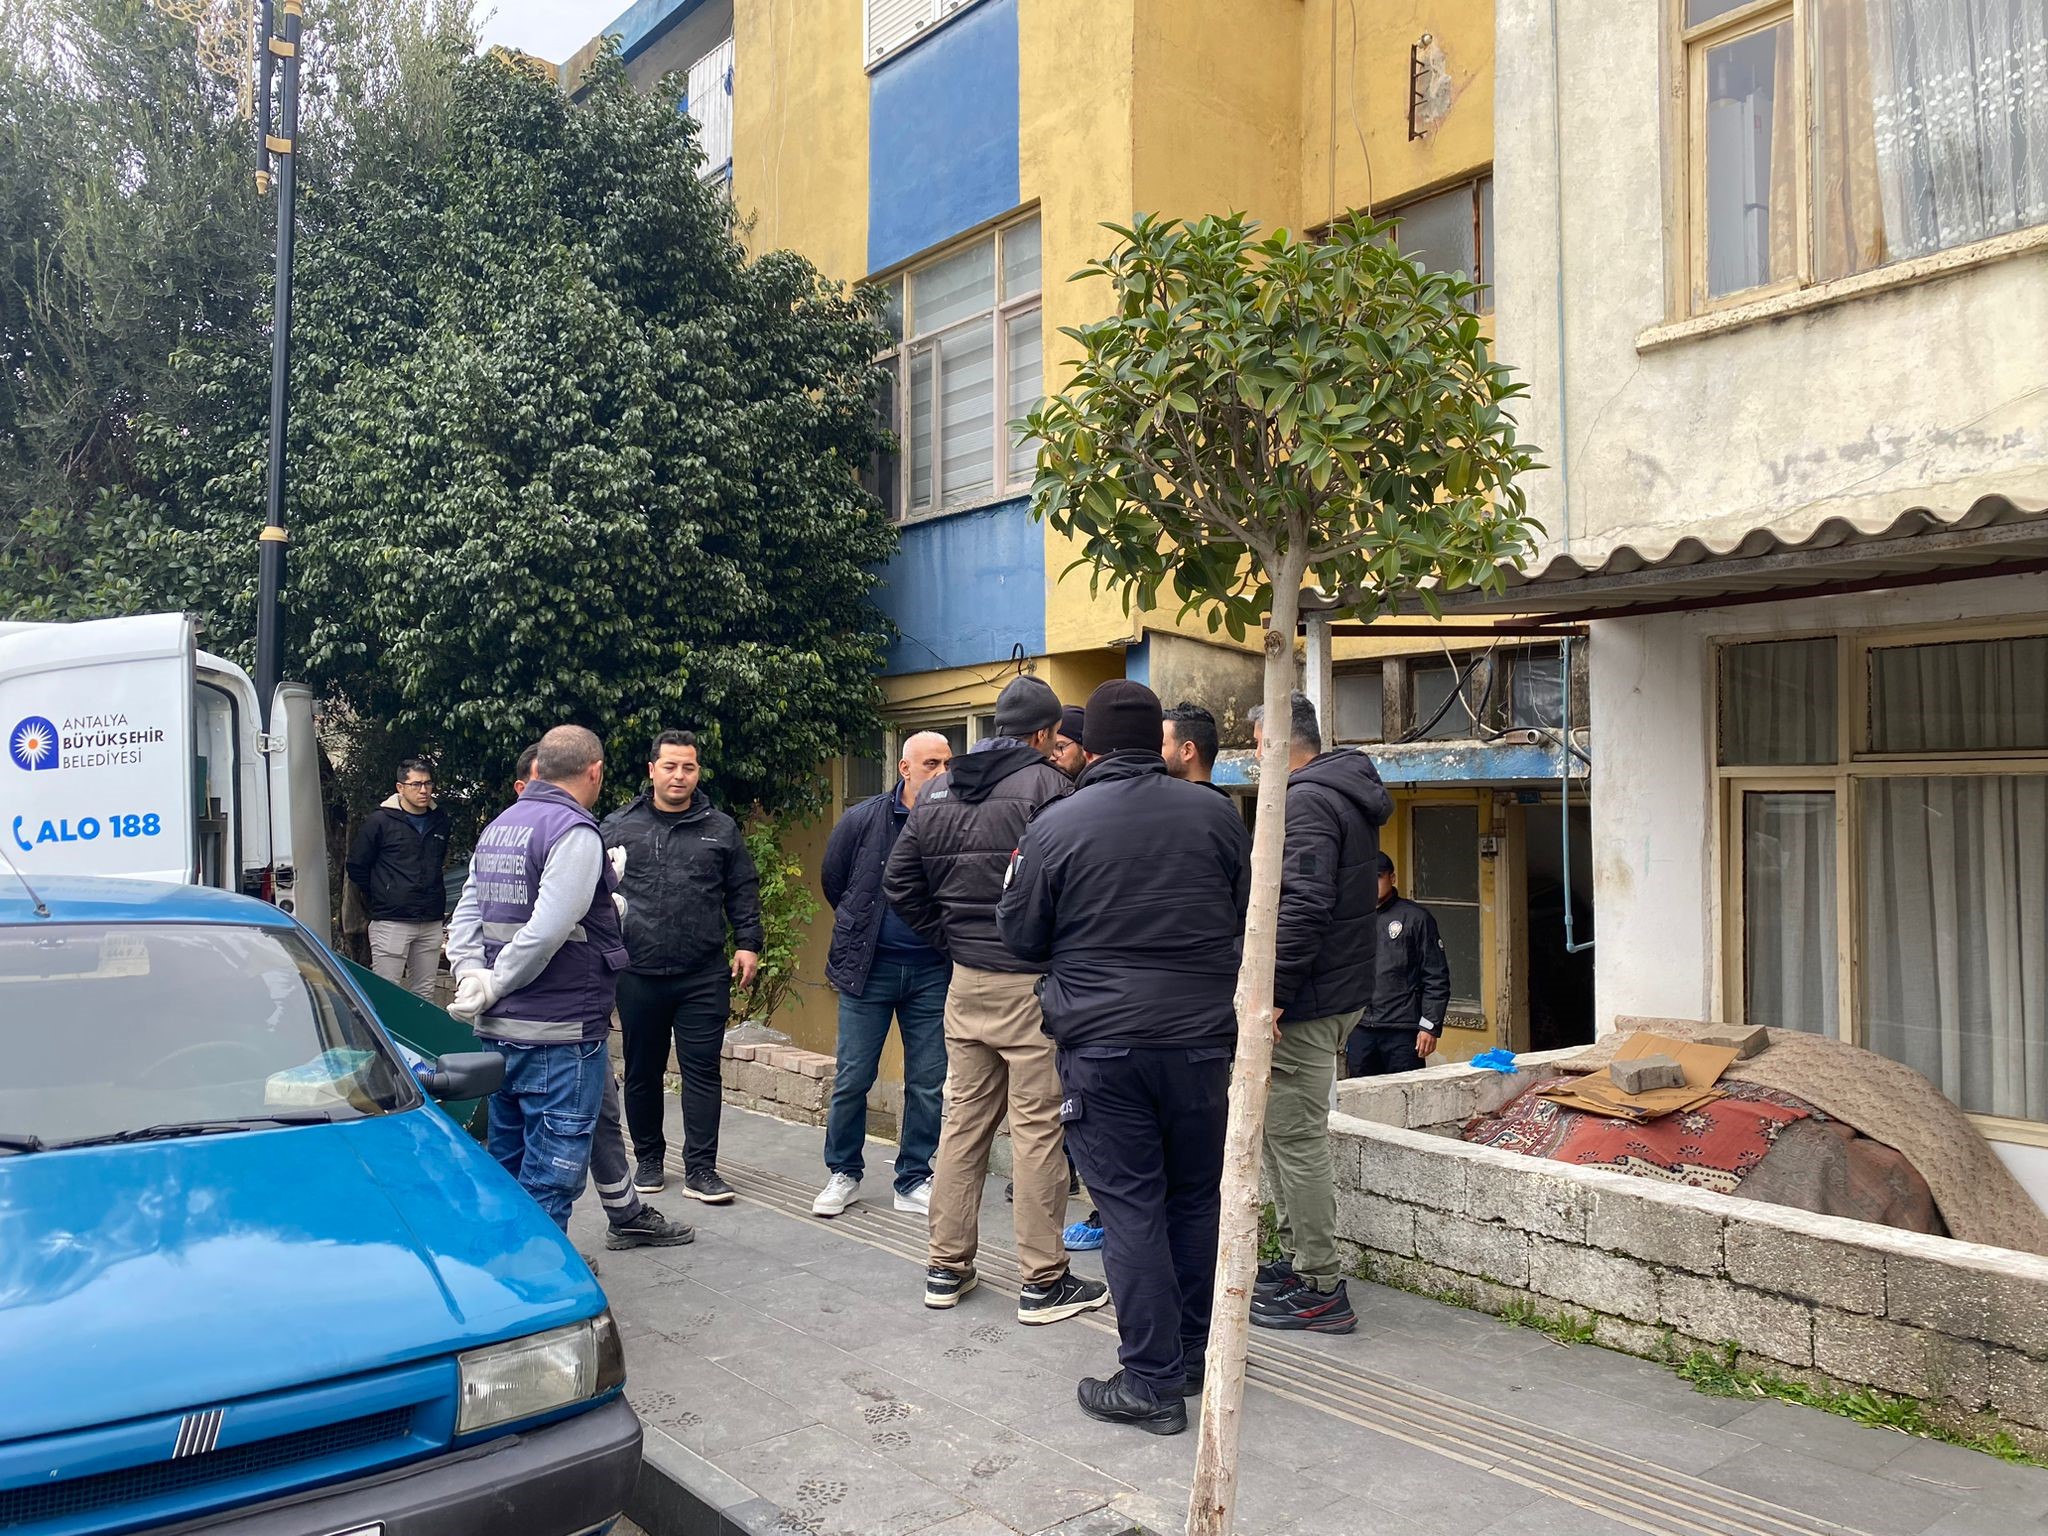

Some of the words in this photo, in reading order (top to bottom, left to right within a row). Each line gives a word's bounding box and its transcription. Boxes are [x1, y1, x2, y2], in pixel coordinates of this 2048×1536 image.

[62, 714, 128, 730] ANTALYA
[63, 726, 164, 749] BÜYÜKŞEHİR
[63, 747, 142, 769] BELEDİYESİ
[35, 817, 100, 843] ALO
[109, 813, 161, 838] 188
[477, 825, 534, 848] ANTALYA
